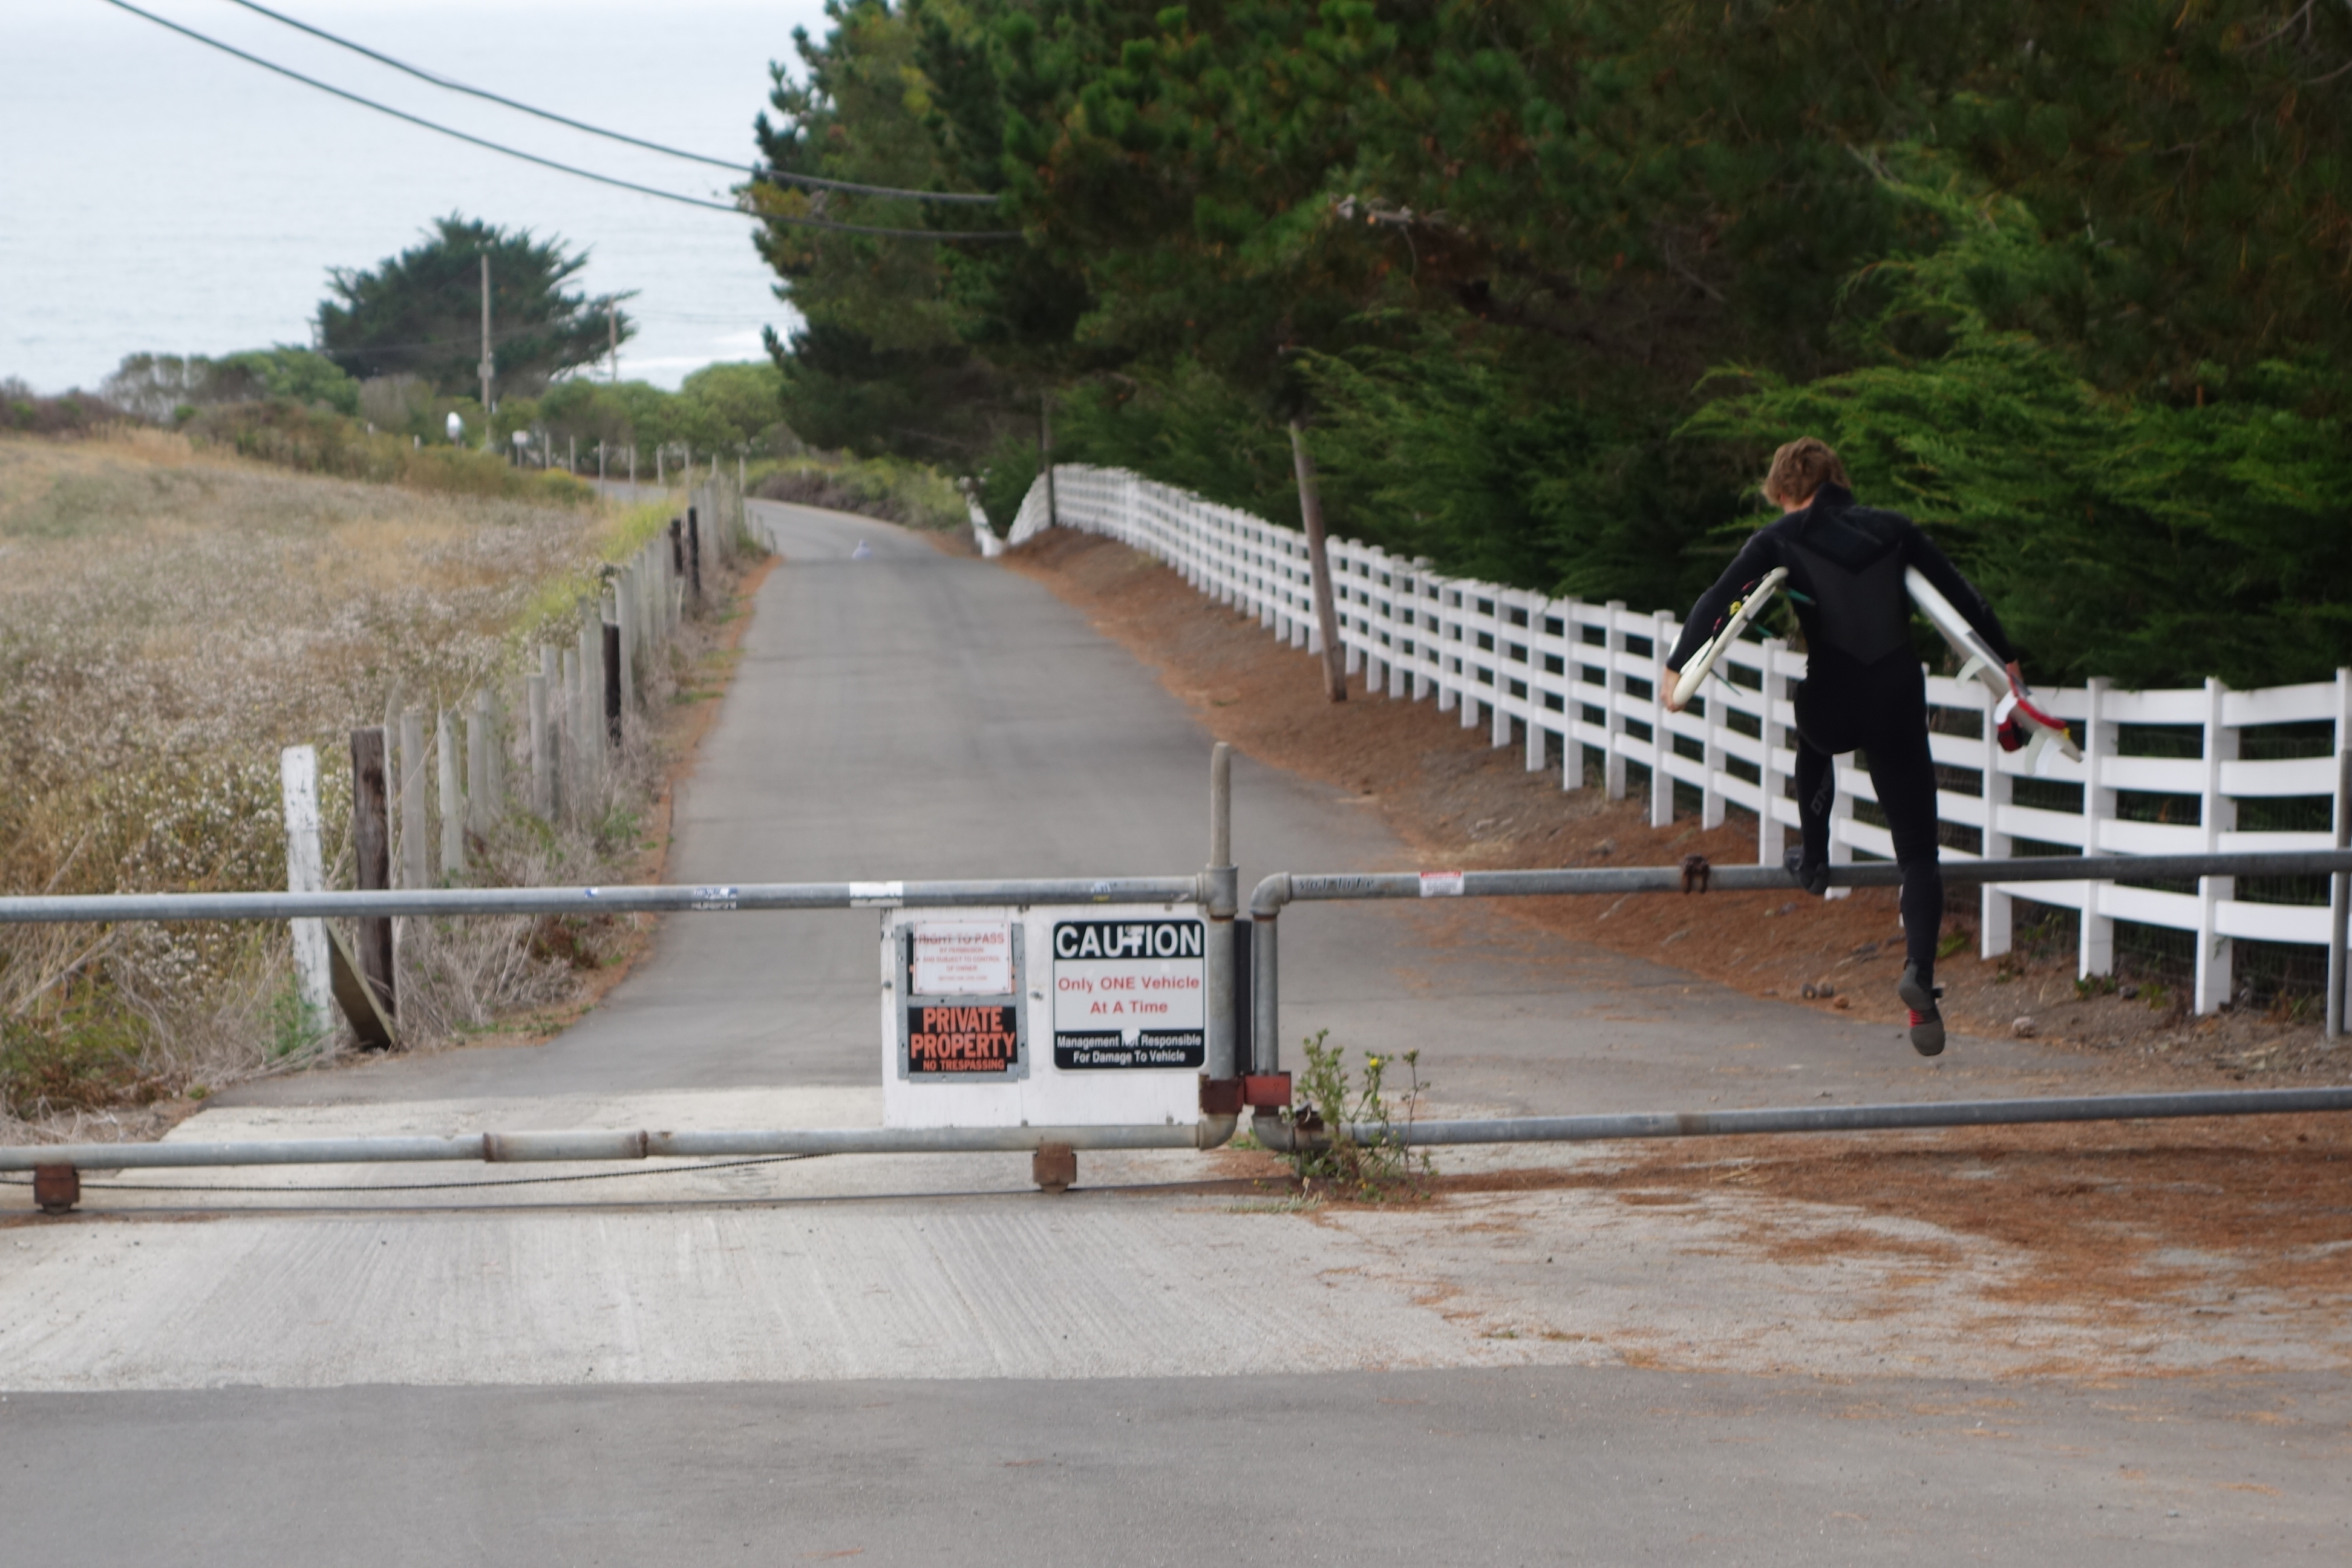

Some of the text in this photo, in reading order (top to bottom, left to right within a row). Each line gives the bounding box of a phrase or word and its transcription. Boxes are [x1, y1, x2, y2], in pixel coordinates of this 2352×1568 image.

[958, 932, 971, 944] TO
[975, 932, 1004, 944] PASS
[1056, 924, 1201, 958] CAUTION
[1058, 975, 1200, 994] Only ONE Vehicle
[1090, 1000, 1168, 1014] At A Time
[923, 1007, 1003, 1033] PRIVATE
[910, 1032, 1015, 1059] PROPERTY
[1057, 1035, 1119, 1050] Management
[1141, 1033, 1201, 1048] Responsible
[923, 1059, 1005, 1071] NO TRESPASSING
[1073, 1048, 1186, 1065] For Damage To Vehicle
